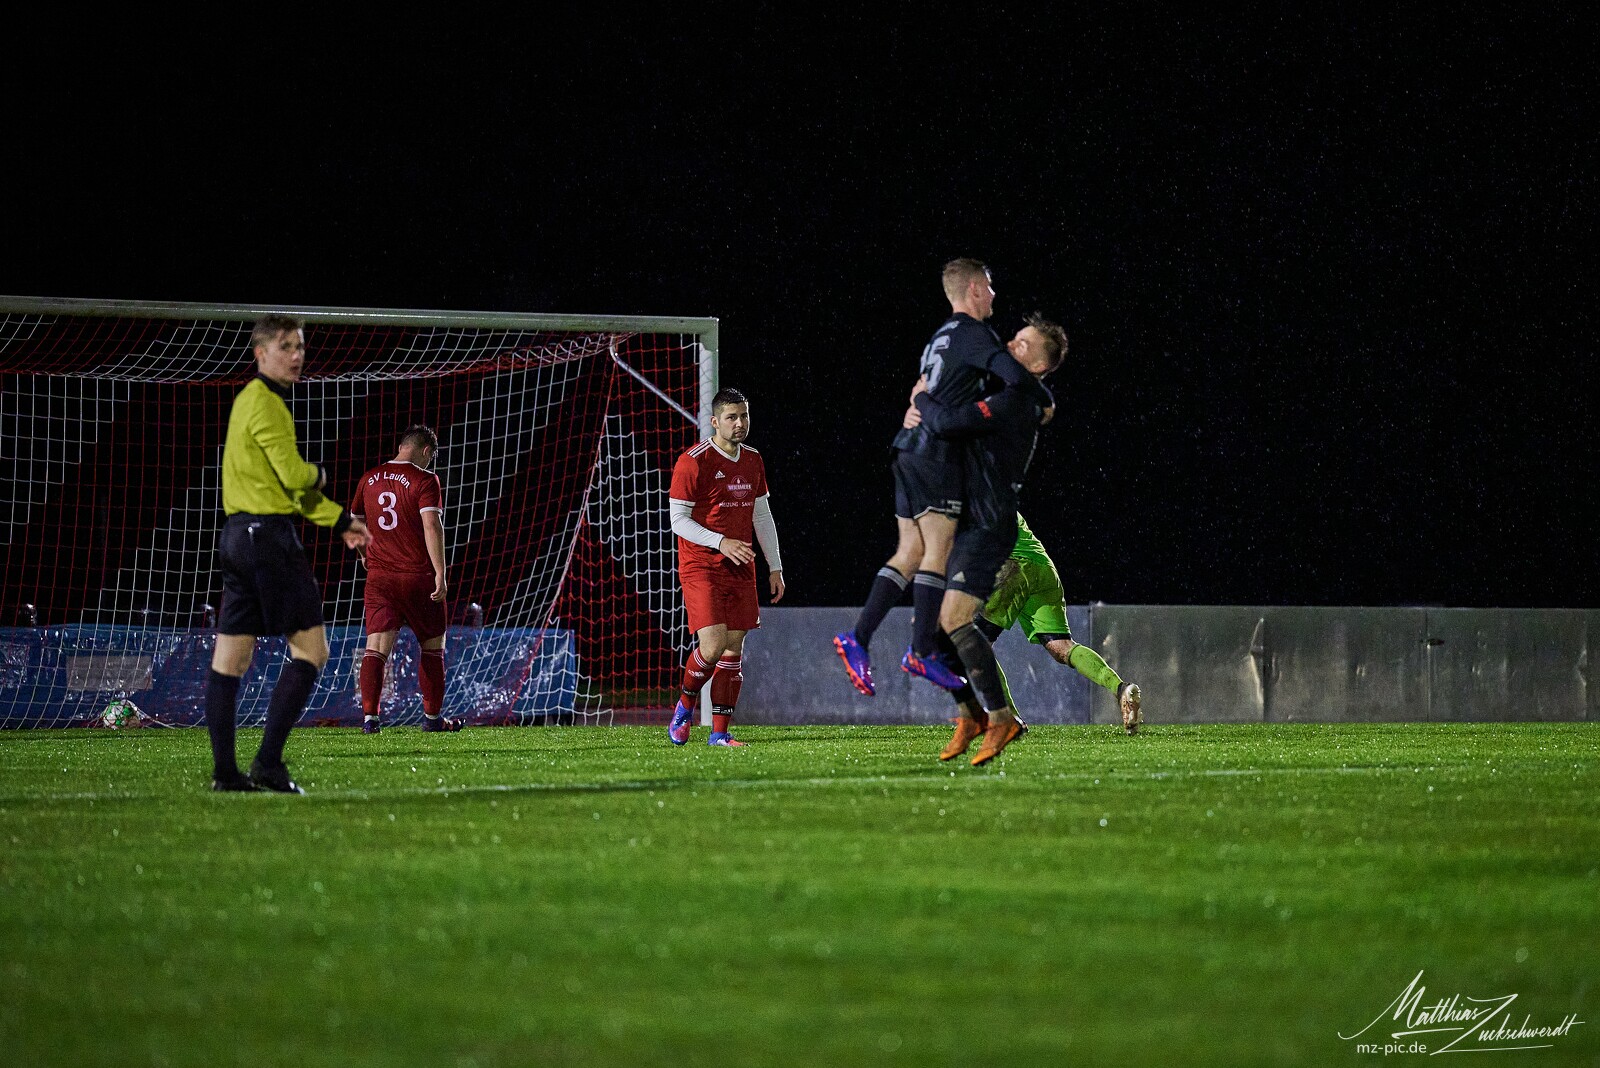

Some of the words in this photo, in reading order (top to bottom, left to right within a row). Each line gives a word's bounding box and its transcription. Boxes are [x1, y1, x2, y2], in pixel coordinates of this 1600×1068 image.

[368, 473, 380, 486] SV
[383, 471, 410, 488] Laufen
[378, 491, 398, 530] 3
